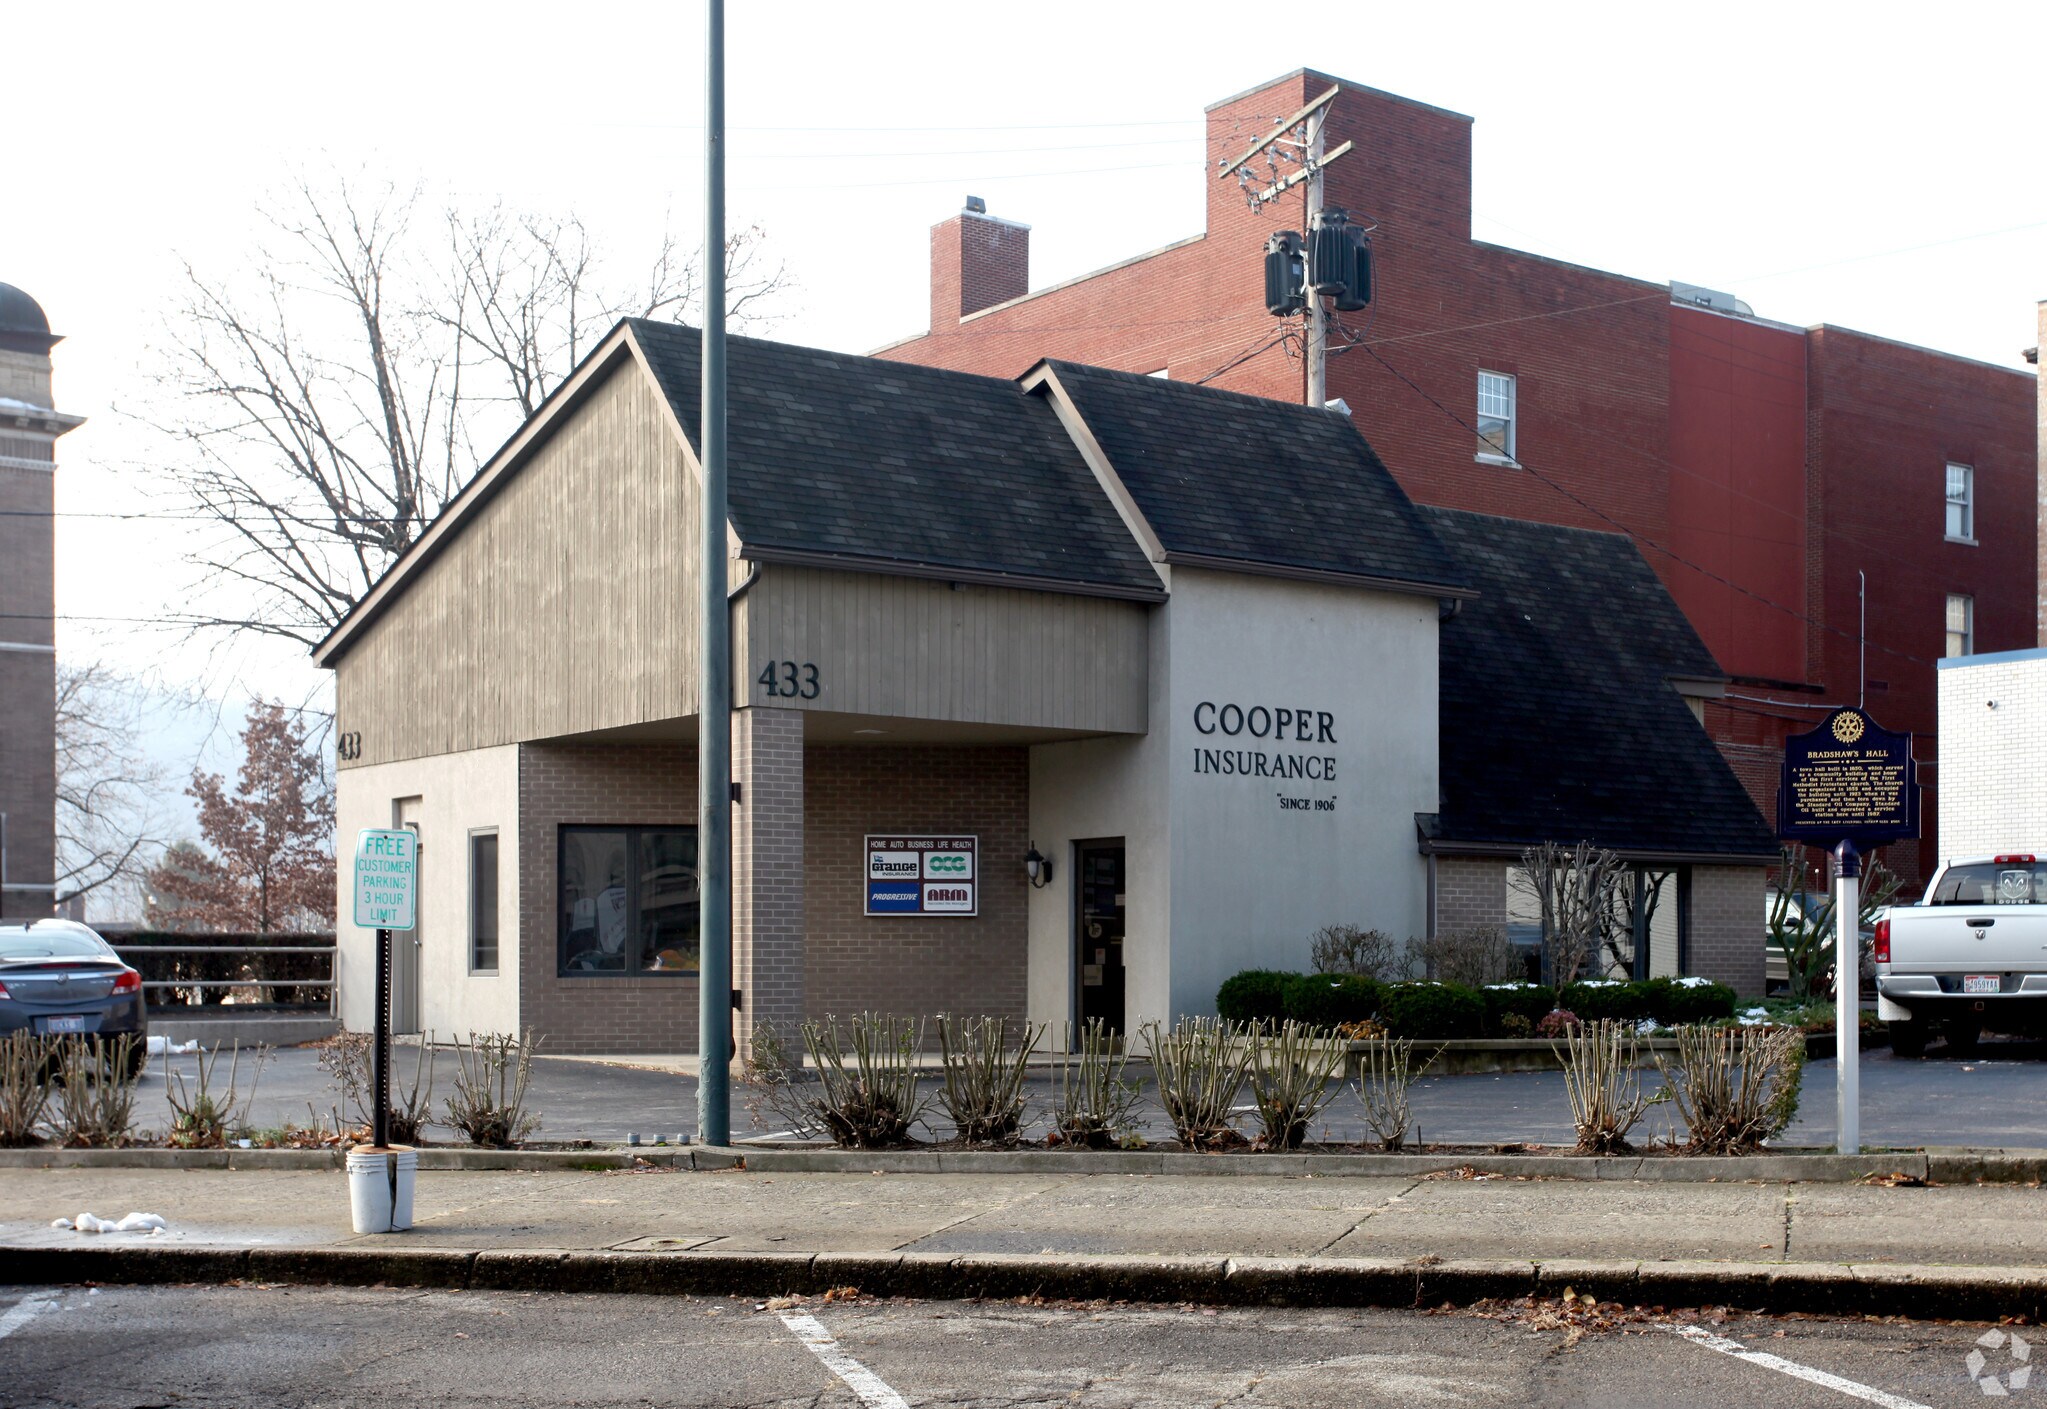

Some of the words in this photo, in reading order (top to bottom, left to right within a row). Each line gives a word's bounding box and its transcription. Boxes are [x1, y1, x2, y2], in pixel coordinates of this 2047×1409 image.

[758, 660, 820, 699] 433
[1194, 702, 1337, 743] COOPER
[338, 731, 361, 760] 433
[1808, 750, 1859, 758] BRADSHAW'S
[1194, 748, 1336, 781] INSURANCE
[366, 837, 405, 856] FREE
[359, 859, 411, 873] CUSTOMER
[363, 876, 406, 889] PARKING
[364, 892, 371, 903] 3
[375, 893, 403, 905] HOUR
[370, 908, 397, 921] LIMIT
